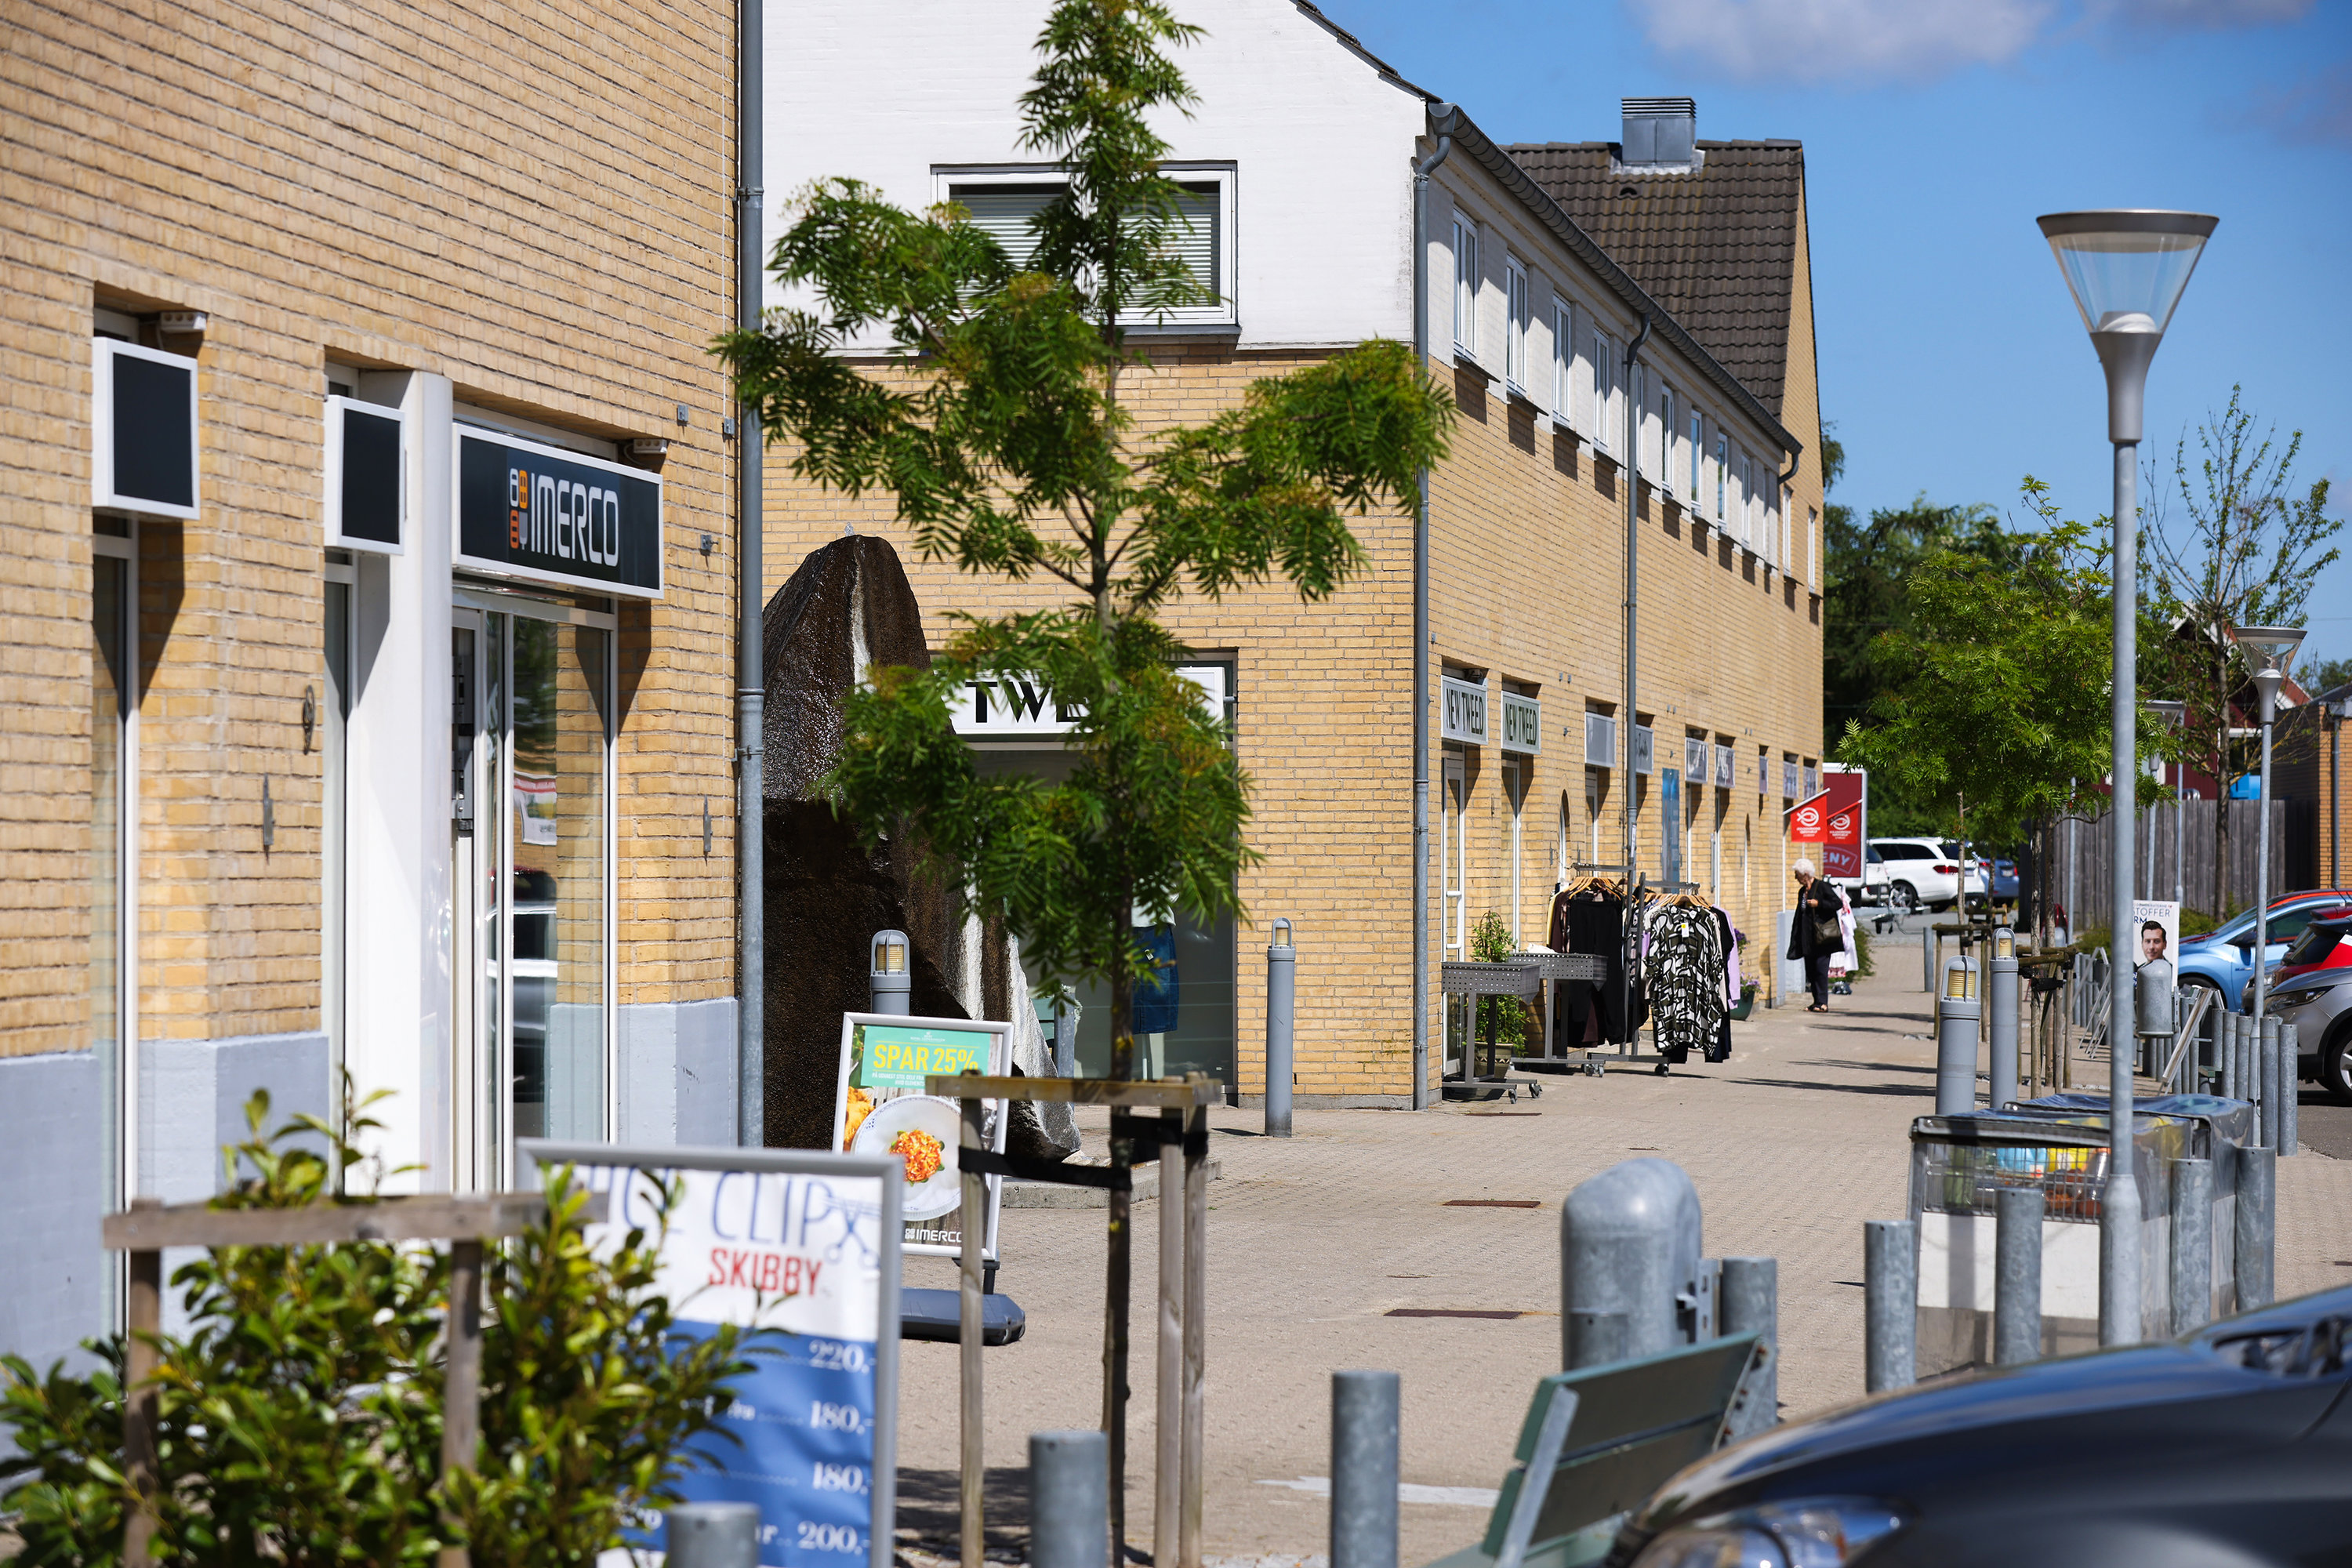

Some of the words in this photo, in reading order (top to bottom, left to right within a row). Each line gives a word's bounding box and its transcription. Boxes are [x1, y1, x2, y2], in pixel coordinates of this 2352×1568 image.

[530, 472, 619, 567] IMERCO
[1446, 688, 1461, 730] NEW
[1461, 691, 1484, 735] TWEED
[1504, 702, 1516, 742] NEW
[1518, 706, 1537, 746] TWEED
[873, 1044, 929, 1071] SPAR
[932, 1047, 978, 1073] 25%
[712, 1168, 834, 1247] CLIP
[708, 1246, 822, 1298] SKIBBY
